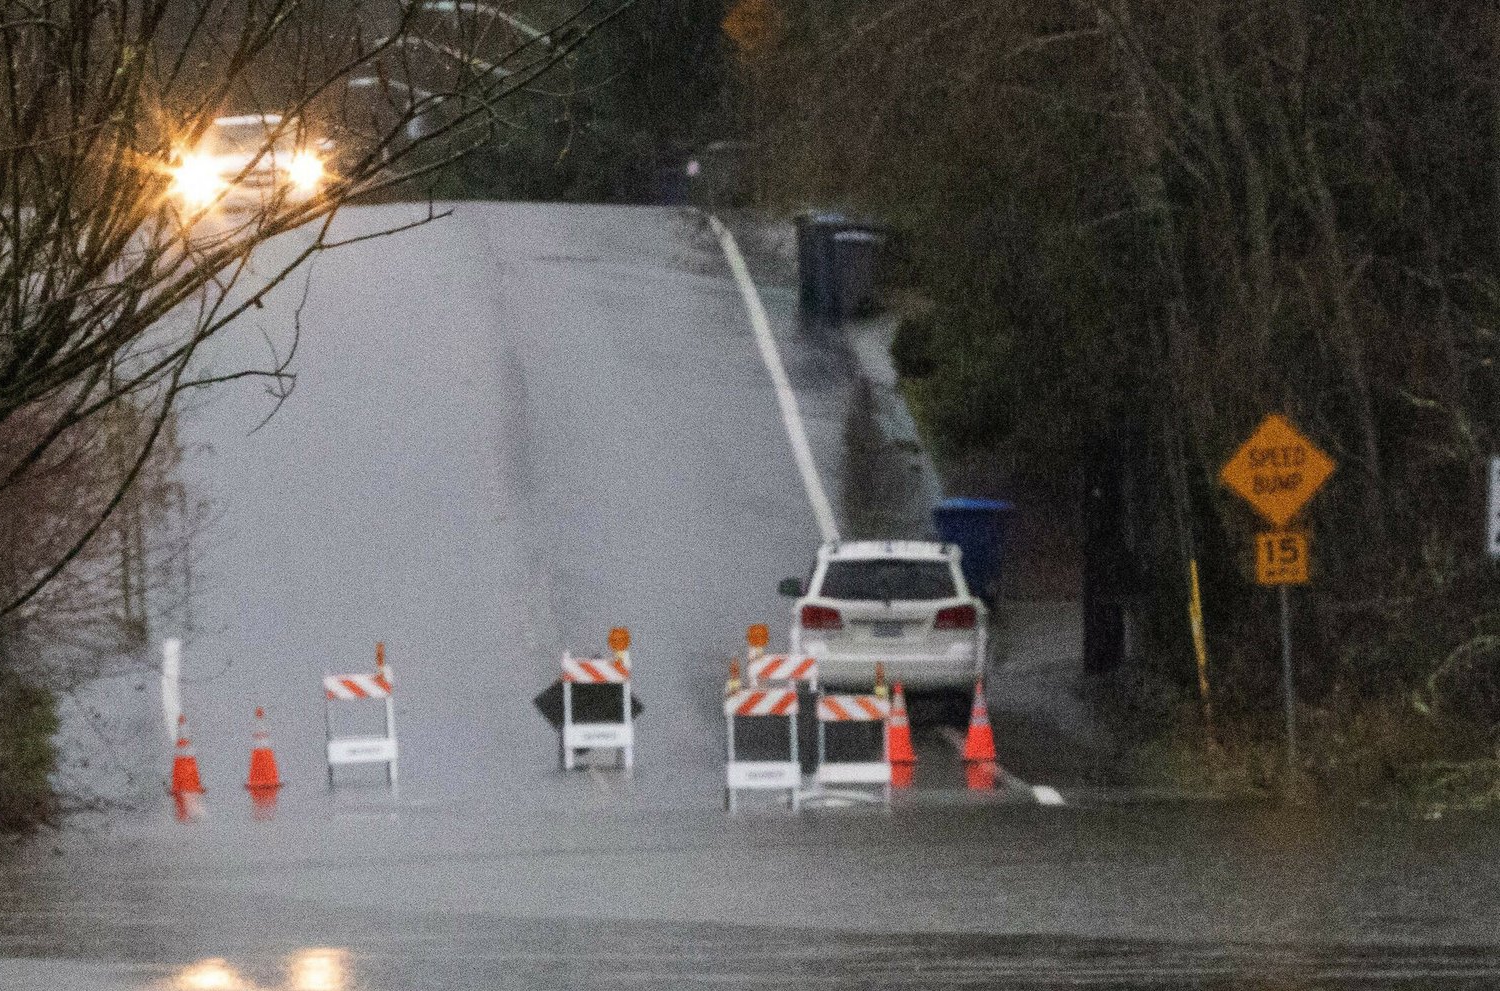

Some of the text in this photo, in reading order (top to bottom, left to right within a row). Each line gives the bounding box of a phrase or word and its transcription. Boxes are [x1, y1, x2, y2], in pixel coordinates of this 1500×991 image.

[1249, 446, 1306, 468] SPEED
[1253, 473, 1303, 495] BUMP
[1266, 537, 1299, 563] 15
